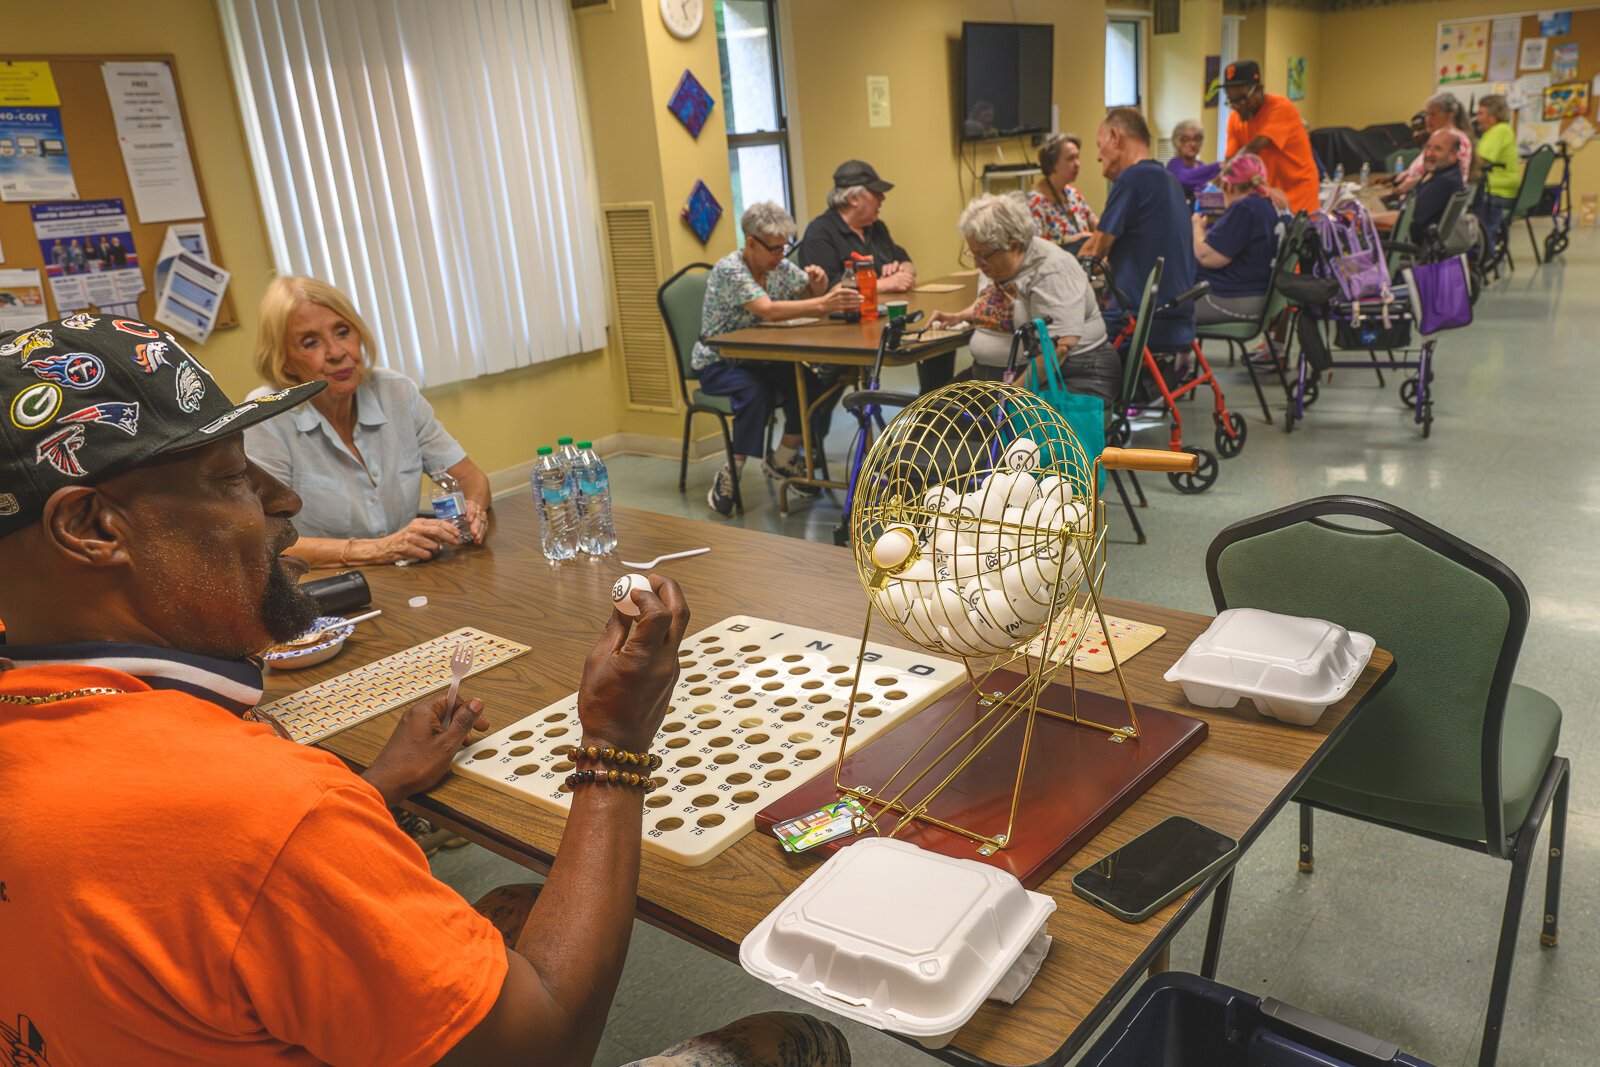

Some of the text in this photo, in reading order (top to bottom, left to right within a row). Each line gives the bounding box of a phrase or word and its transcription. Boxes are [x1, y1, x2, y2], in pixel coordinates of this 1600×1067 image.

[726, 624, 750, 633] B
[805, 640, 833, 651] N
[907, 664, 936, 676] O
[770, 722, 784, 730] 56
[780, 742, 794, 750] 64
[500, 756, 512, 764] 15
[540, 755, 555, 763] 22
[666, 766, 681, 775] 51
[705, 763, 719, 772] 58
[749, 762, 763, 771] 65
[504, 774, 519, 782] 23
[541, 772, 555, 780] 30
[671, 785, 686, 793] 59
[717, 784, 732, 792] 66
[758, 781, 772, 789] 73
[549, 791, 564, 799] 38
[683, 806, 699, 814] 67
[725, 803, 740, 812] 74
[648, 829, 663, 838] 68
[690, 827, 706, 836] 75
